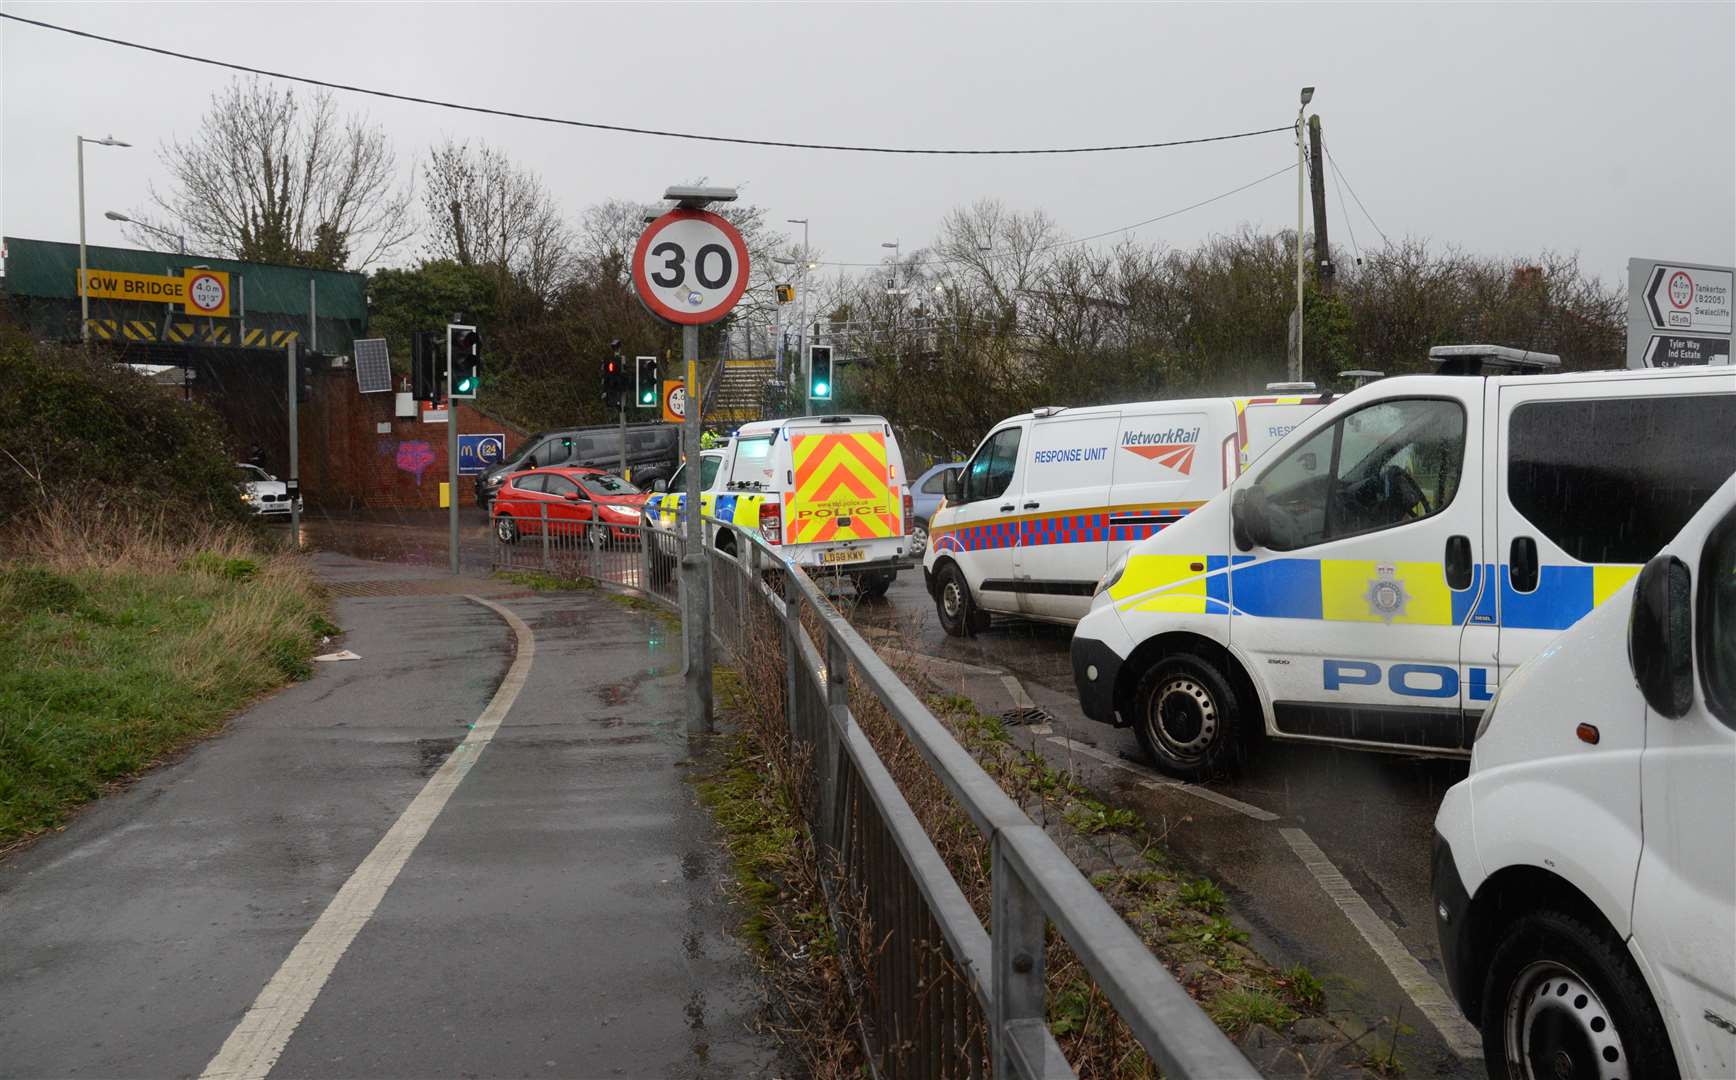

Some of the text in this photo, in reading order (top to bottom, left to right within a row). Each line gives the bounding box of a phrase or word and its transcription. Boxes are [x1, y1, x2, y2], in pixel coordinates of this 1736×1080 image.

[651, 241, 732, 290] 30
[124, 279, 183, 297] BRIDGE
[1695, 284, 1727, 294] Tankerton
[1695, 294, 1725, 305] (B2205)
[1669, 339, 1700, 350] Tyler Way
[1668, 349, 1701, 359] Ind Estate
[1121, 427, 1200, 445] NetworkRail
[1034, 447, 1107, 463] RESPONSE UNIT
[798, 505, 888, 519] POLICE
